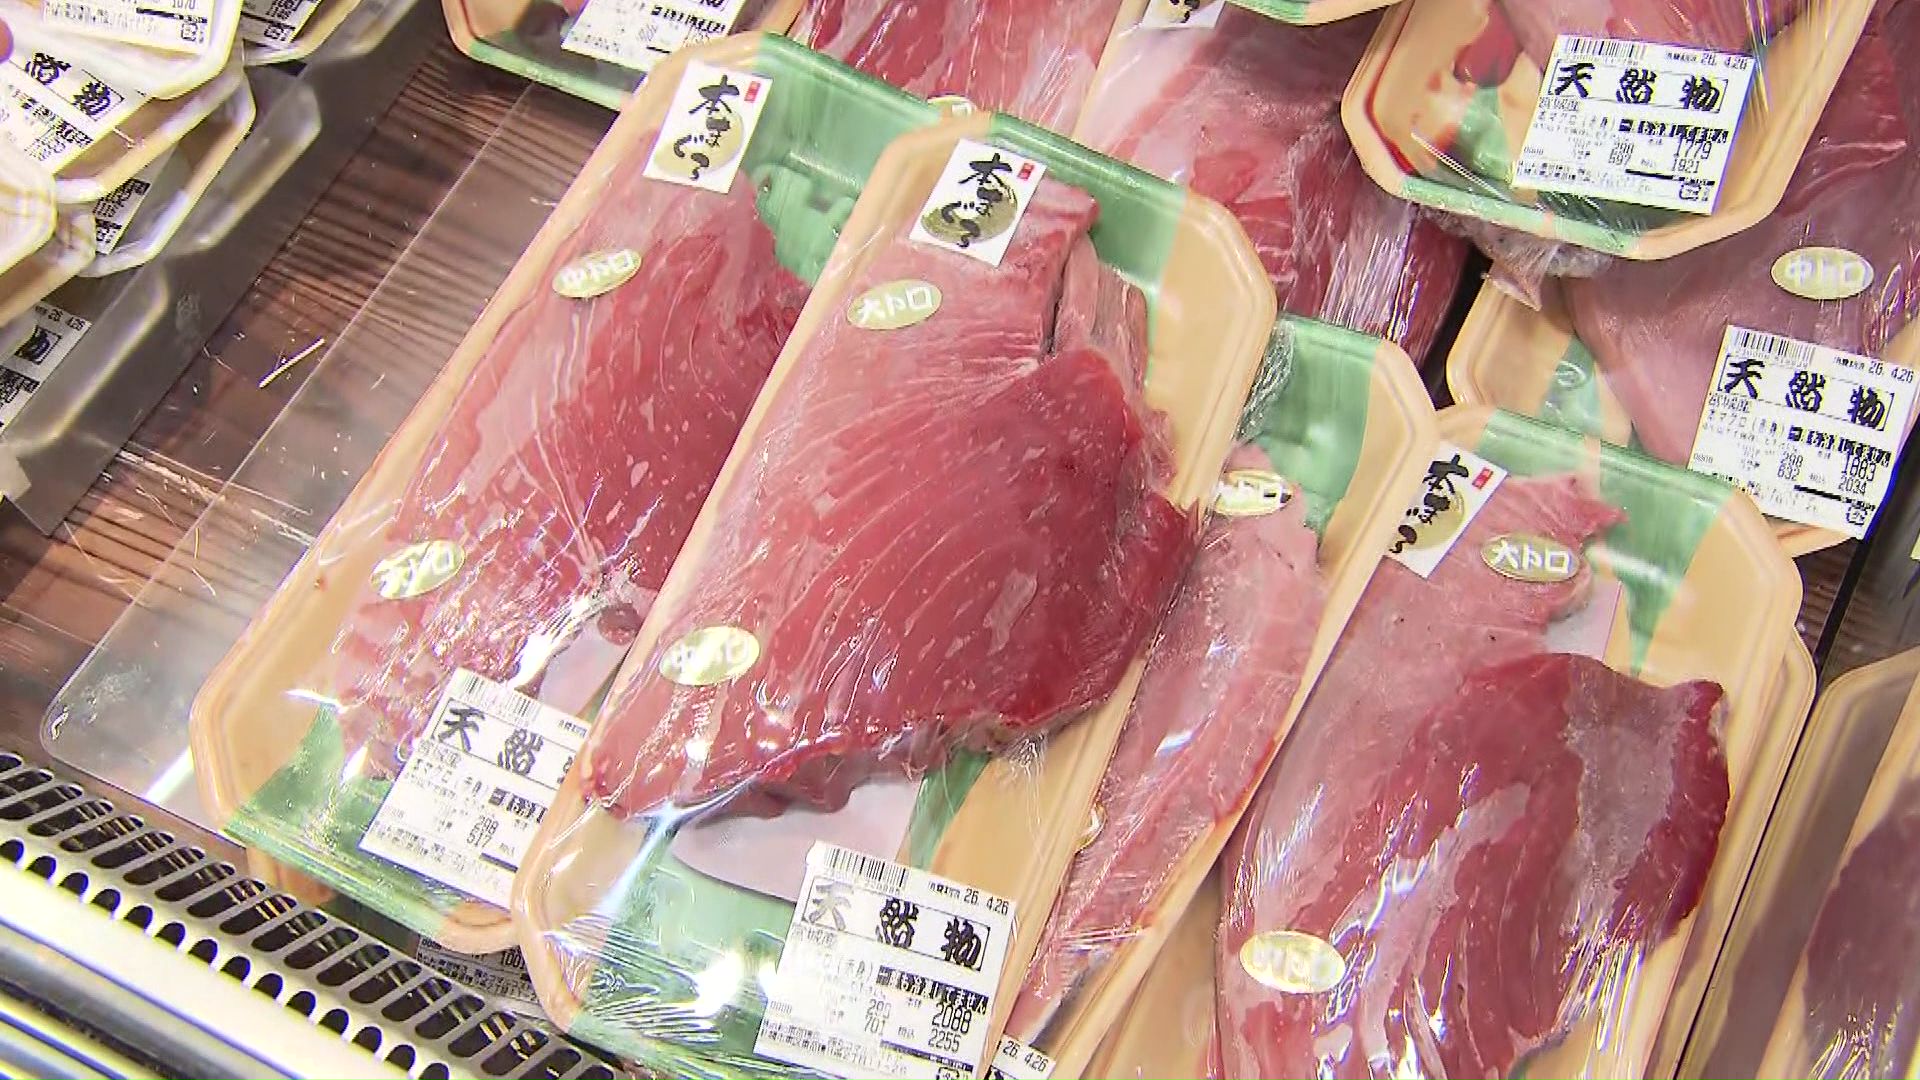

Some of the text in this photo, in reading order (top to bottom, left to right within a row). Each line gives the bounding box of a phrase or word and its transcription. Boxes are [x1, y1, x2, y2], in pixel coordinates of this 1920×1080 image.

[1553, 62, 1722, 113] 天然物
[1671, 158, 1700, 174] 1921
[855, 286, 935, 327] 大トロ
[1891, 367, 1914, 383] 4.26
[1723, 358, 1887, 430] 天然物
[1838, 475, 1867, 495] 2034
[1490, 540, 1571, 574] 大トロ
[963, 887, 981, 906] 26.
[985, 897, 1010, 916] 4.26
[805, 884, 983, 968] 天然物
[931, 1001, 972, 1035] 2088
[927, 1028, 962, 1053] 2255
[1002, 1040, 1049, 1072] 26. 4.26
